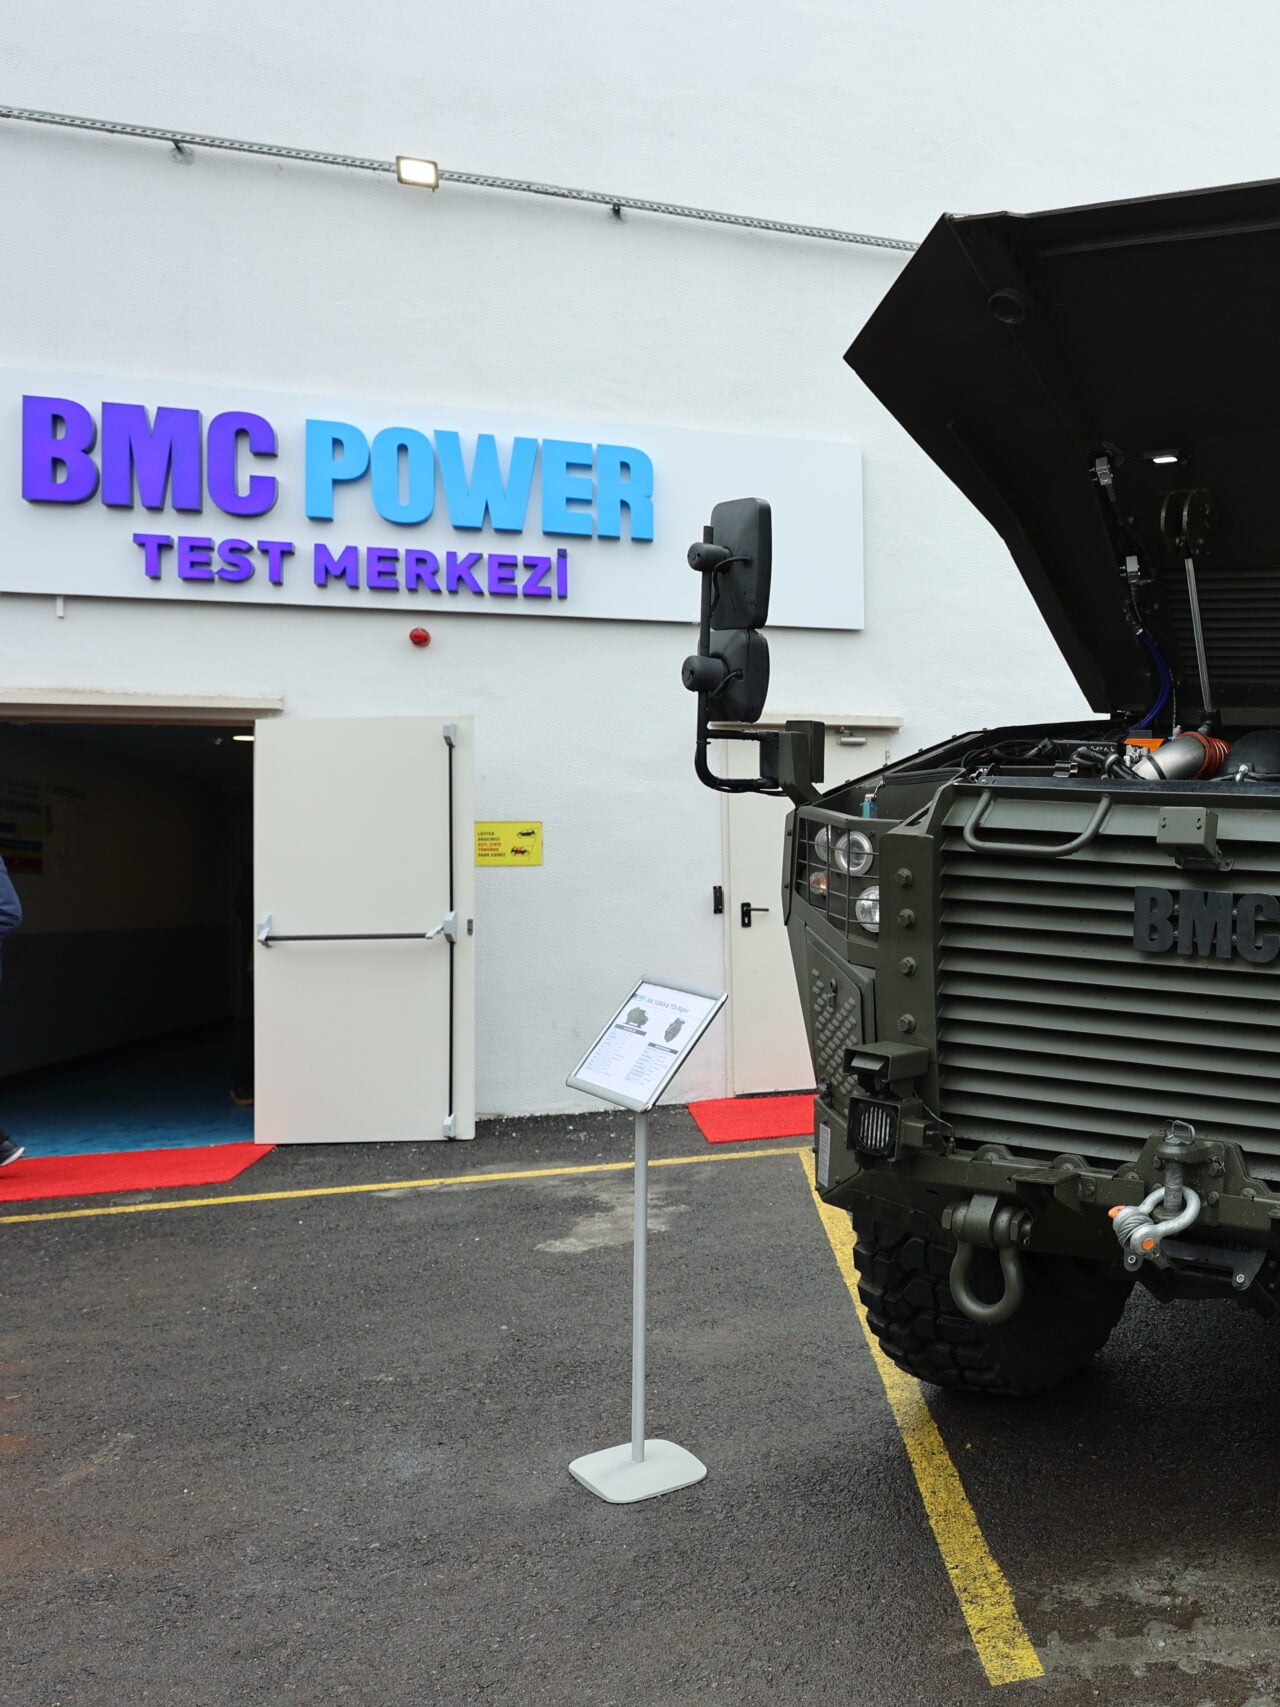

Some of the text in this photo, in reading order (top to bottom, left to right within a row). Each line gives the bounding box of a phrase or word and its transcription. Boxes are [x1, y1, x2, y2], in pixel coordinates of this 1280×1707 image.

[21, 394, 655, 543] BMC POWER
[133, 532, 569, 600] TEST MERKEZİ
[1133, 886, 1280, 964] BMC
